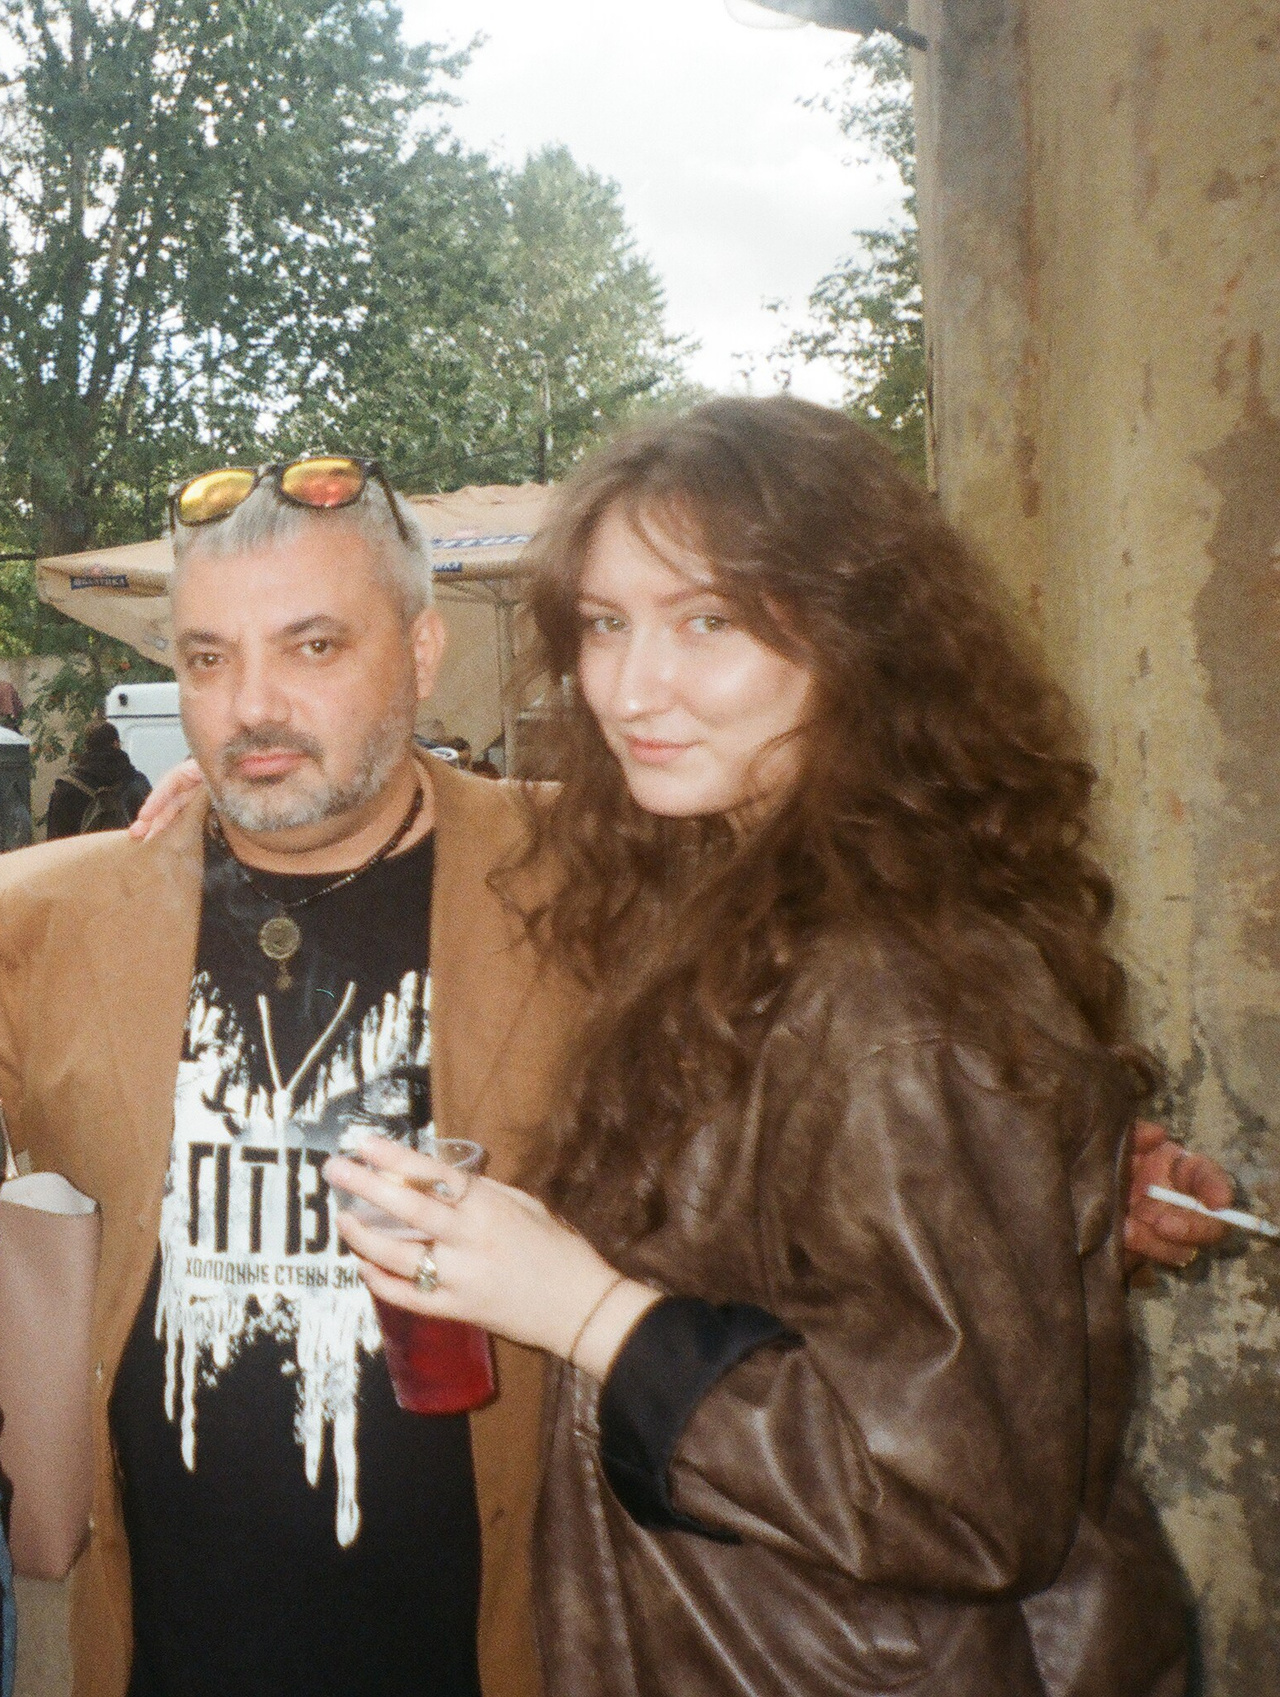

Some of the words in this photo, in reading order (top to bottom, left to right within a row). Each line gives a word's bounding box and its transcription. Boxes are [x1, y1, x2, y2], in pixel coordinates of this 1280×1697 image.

[188, 1141, 352, 1257] ПТВ
[185, 1256, 270, 1286] ХОЛОДНЫЕ
[274, 1263, 329, 1288] СТЕНЫ
